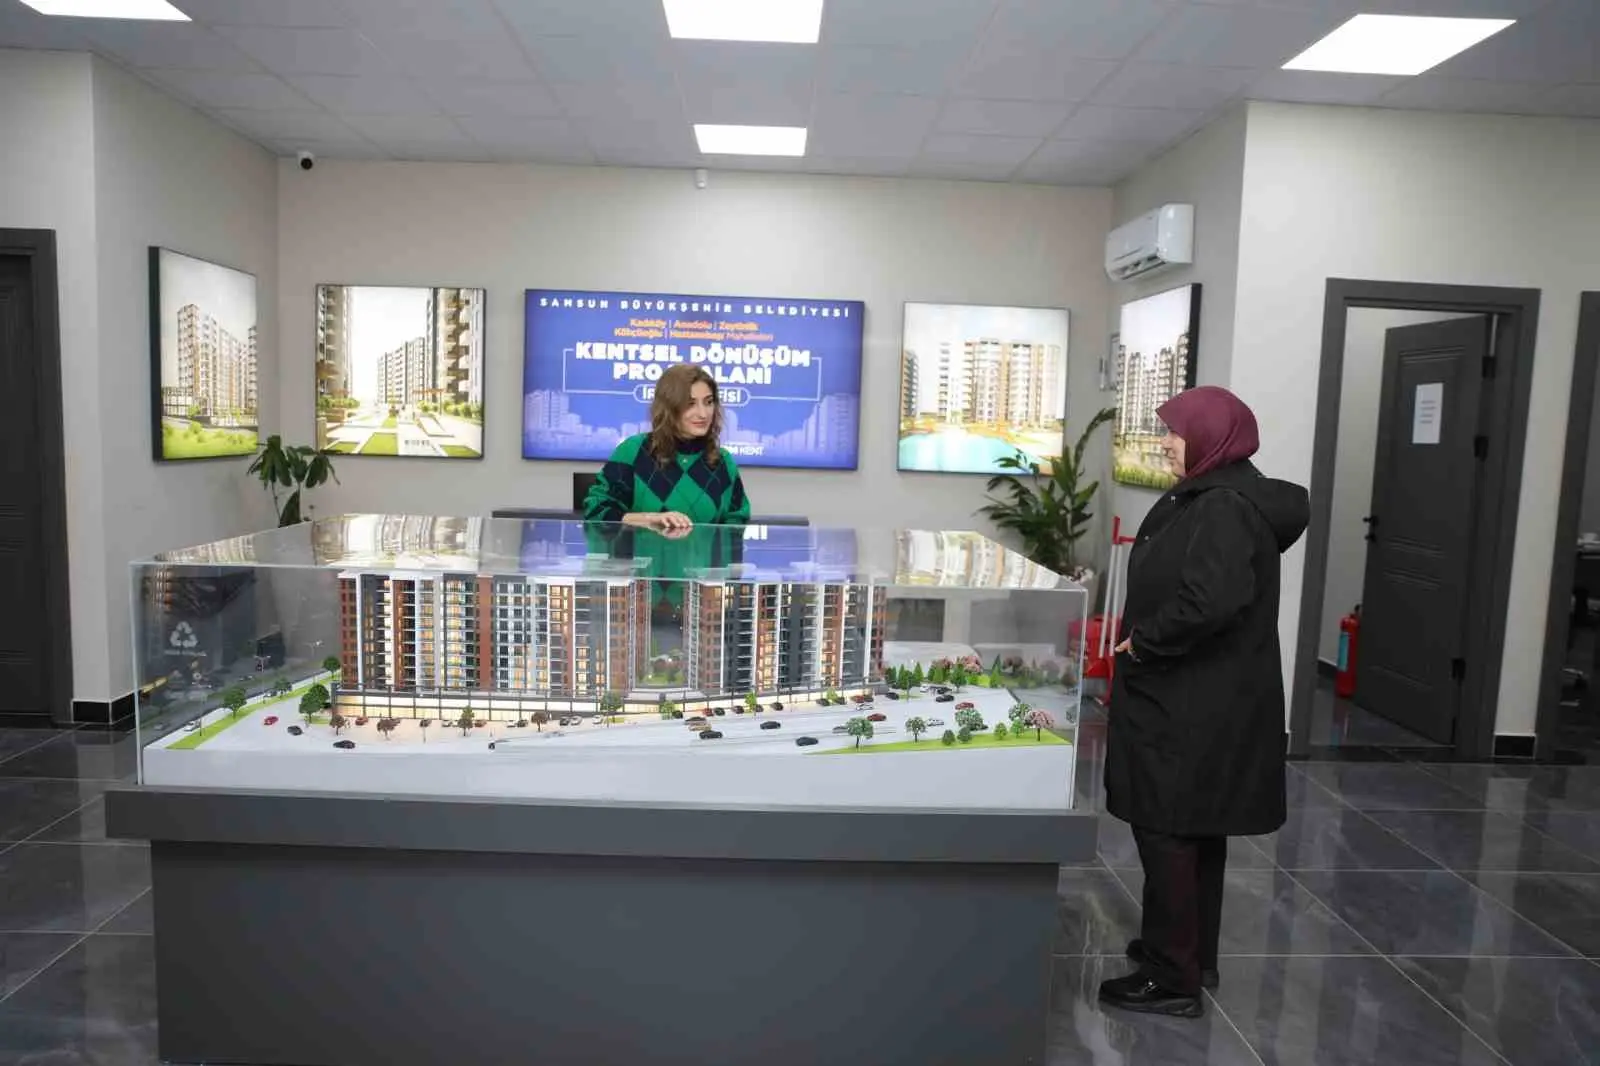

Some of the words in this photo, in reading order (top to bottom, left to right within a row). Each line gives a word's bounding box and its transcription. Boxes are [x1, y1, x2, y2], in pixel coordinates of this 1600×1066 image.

[540, 298, 609, 309] SAMSUN
[620, 299, 733, 313] BÜYÜKŞEHİR
[743, 304, 850, 317] BELEDİYESİ
[575, 341, 684, 361] KENTSEL
[689, 342, 811, 368] DÖNÜŞÜM
